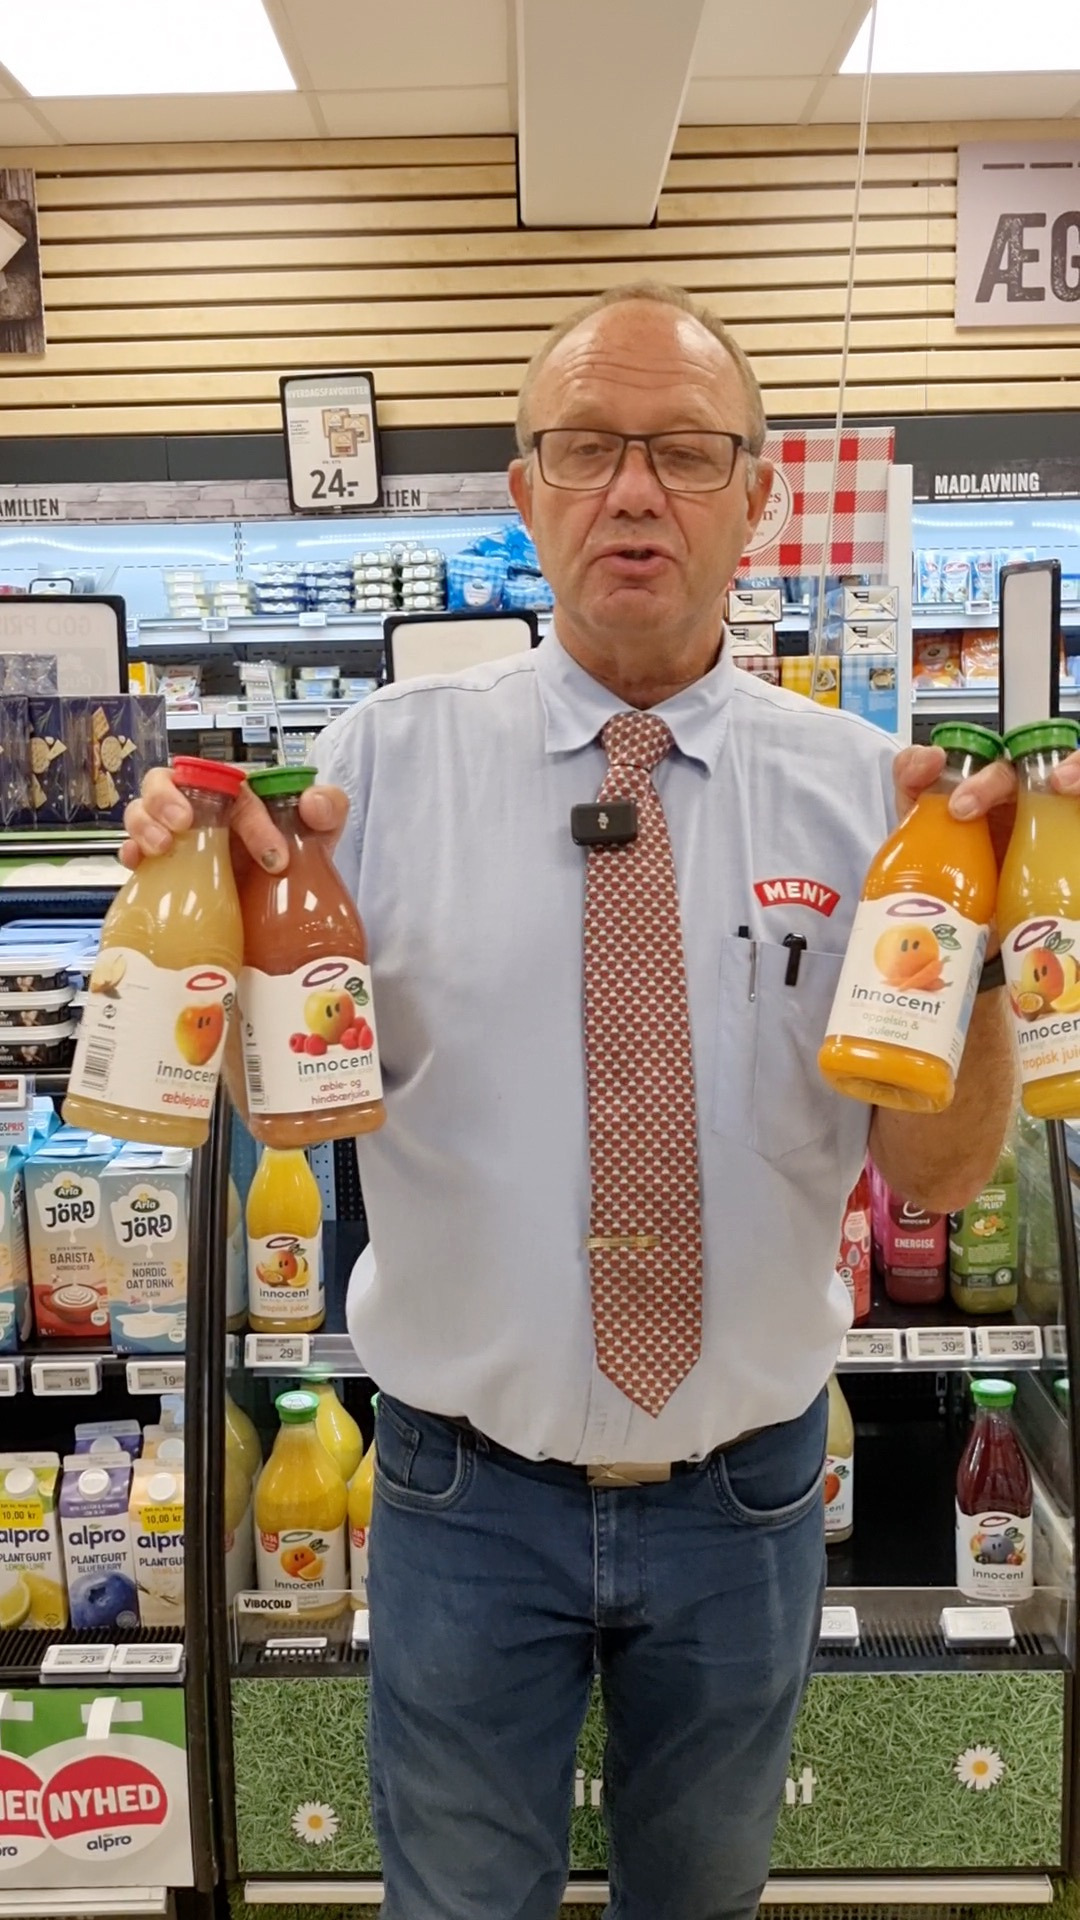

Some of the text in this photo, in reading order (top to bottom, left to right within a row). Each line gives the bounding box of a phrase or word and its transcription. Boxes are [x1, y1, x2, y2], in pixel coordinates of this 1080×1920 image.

[934, 472, 1040, 494] MADLAVNING
[382, 489, 420, 507] LIEN
[762, 881, 832, 906] MENY
[851, 984, 942, 1015] innocent
[1062, 1044, 1080, 1064] jui
[297, 1052, 374, 1076] innocent
[156, 1060, 217, 1083] innocen
[350, 1079, 361, 1092] og
[58, 1184, 80, 1197] Arla
[134, 1198, 156, 1211] Arla
[894, 1238, 936, 1249] ENERGISE
[50, 1252, 95, 1264] BARISTA
[132, 1267, 167, 1278] NORDIC
[126, 1279, 174, 1289] OAT DRINK
[259, 1287, 309, 1299] innocent
[870, 1343, 884, 1353] 29
[941, 1341, 956, 1351] 39
[1012, 1340, 1026, 1350] 39
[280, 1348, 294, 1358] 29
[69, 1377, 81, 1386] 18
[163, 1375, 176, 1385] 19
[3, 1511, 24, 1520] 10,00
[147, 1514, 169, 1524] 10,00
[69, 1525, 126, 1549] alpro
[78, 1563, 122, 1573] BLUEBERRY
[972, 1568, 1024, 1580] innocent
[274, 1579, 325, 1590] innocent
[243, 1598, 292, 1610] VIBOCOLD
[80, 1655, 95, 1664] 23
[148, 1655, 164, 1664] 23
[0, 1789, 41, 1821] ED
[49, 1783, 161, 1823] NYHED
[87, 1835, 132, 1852] alpro
